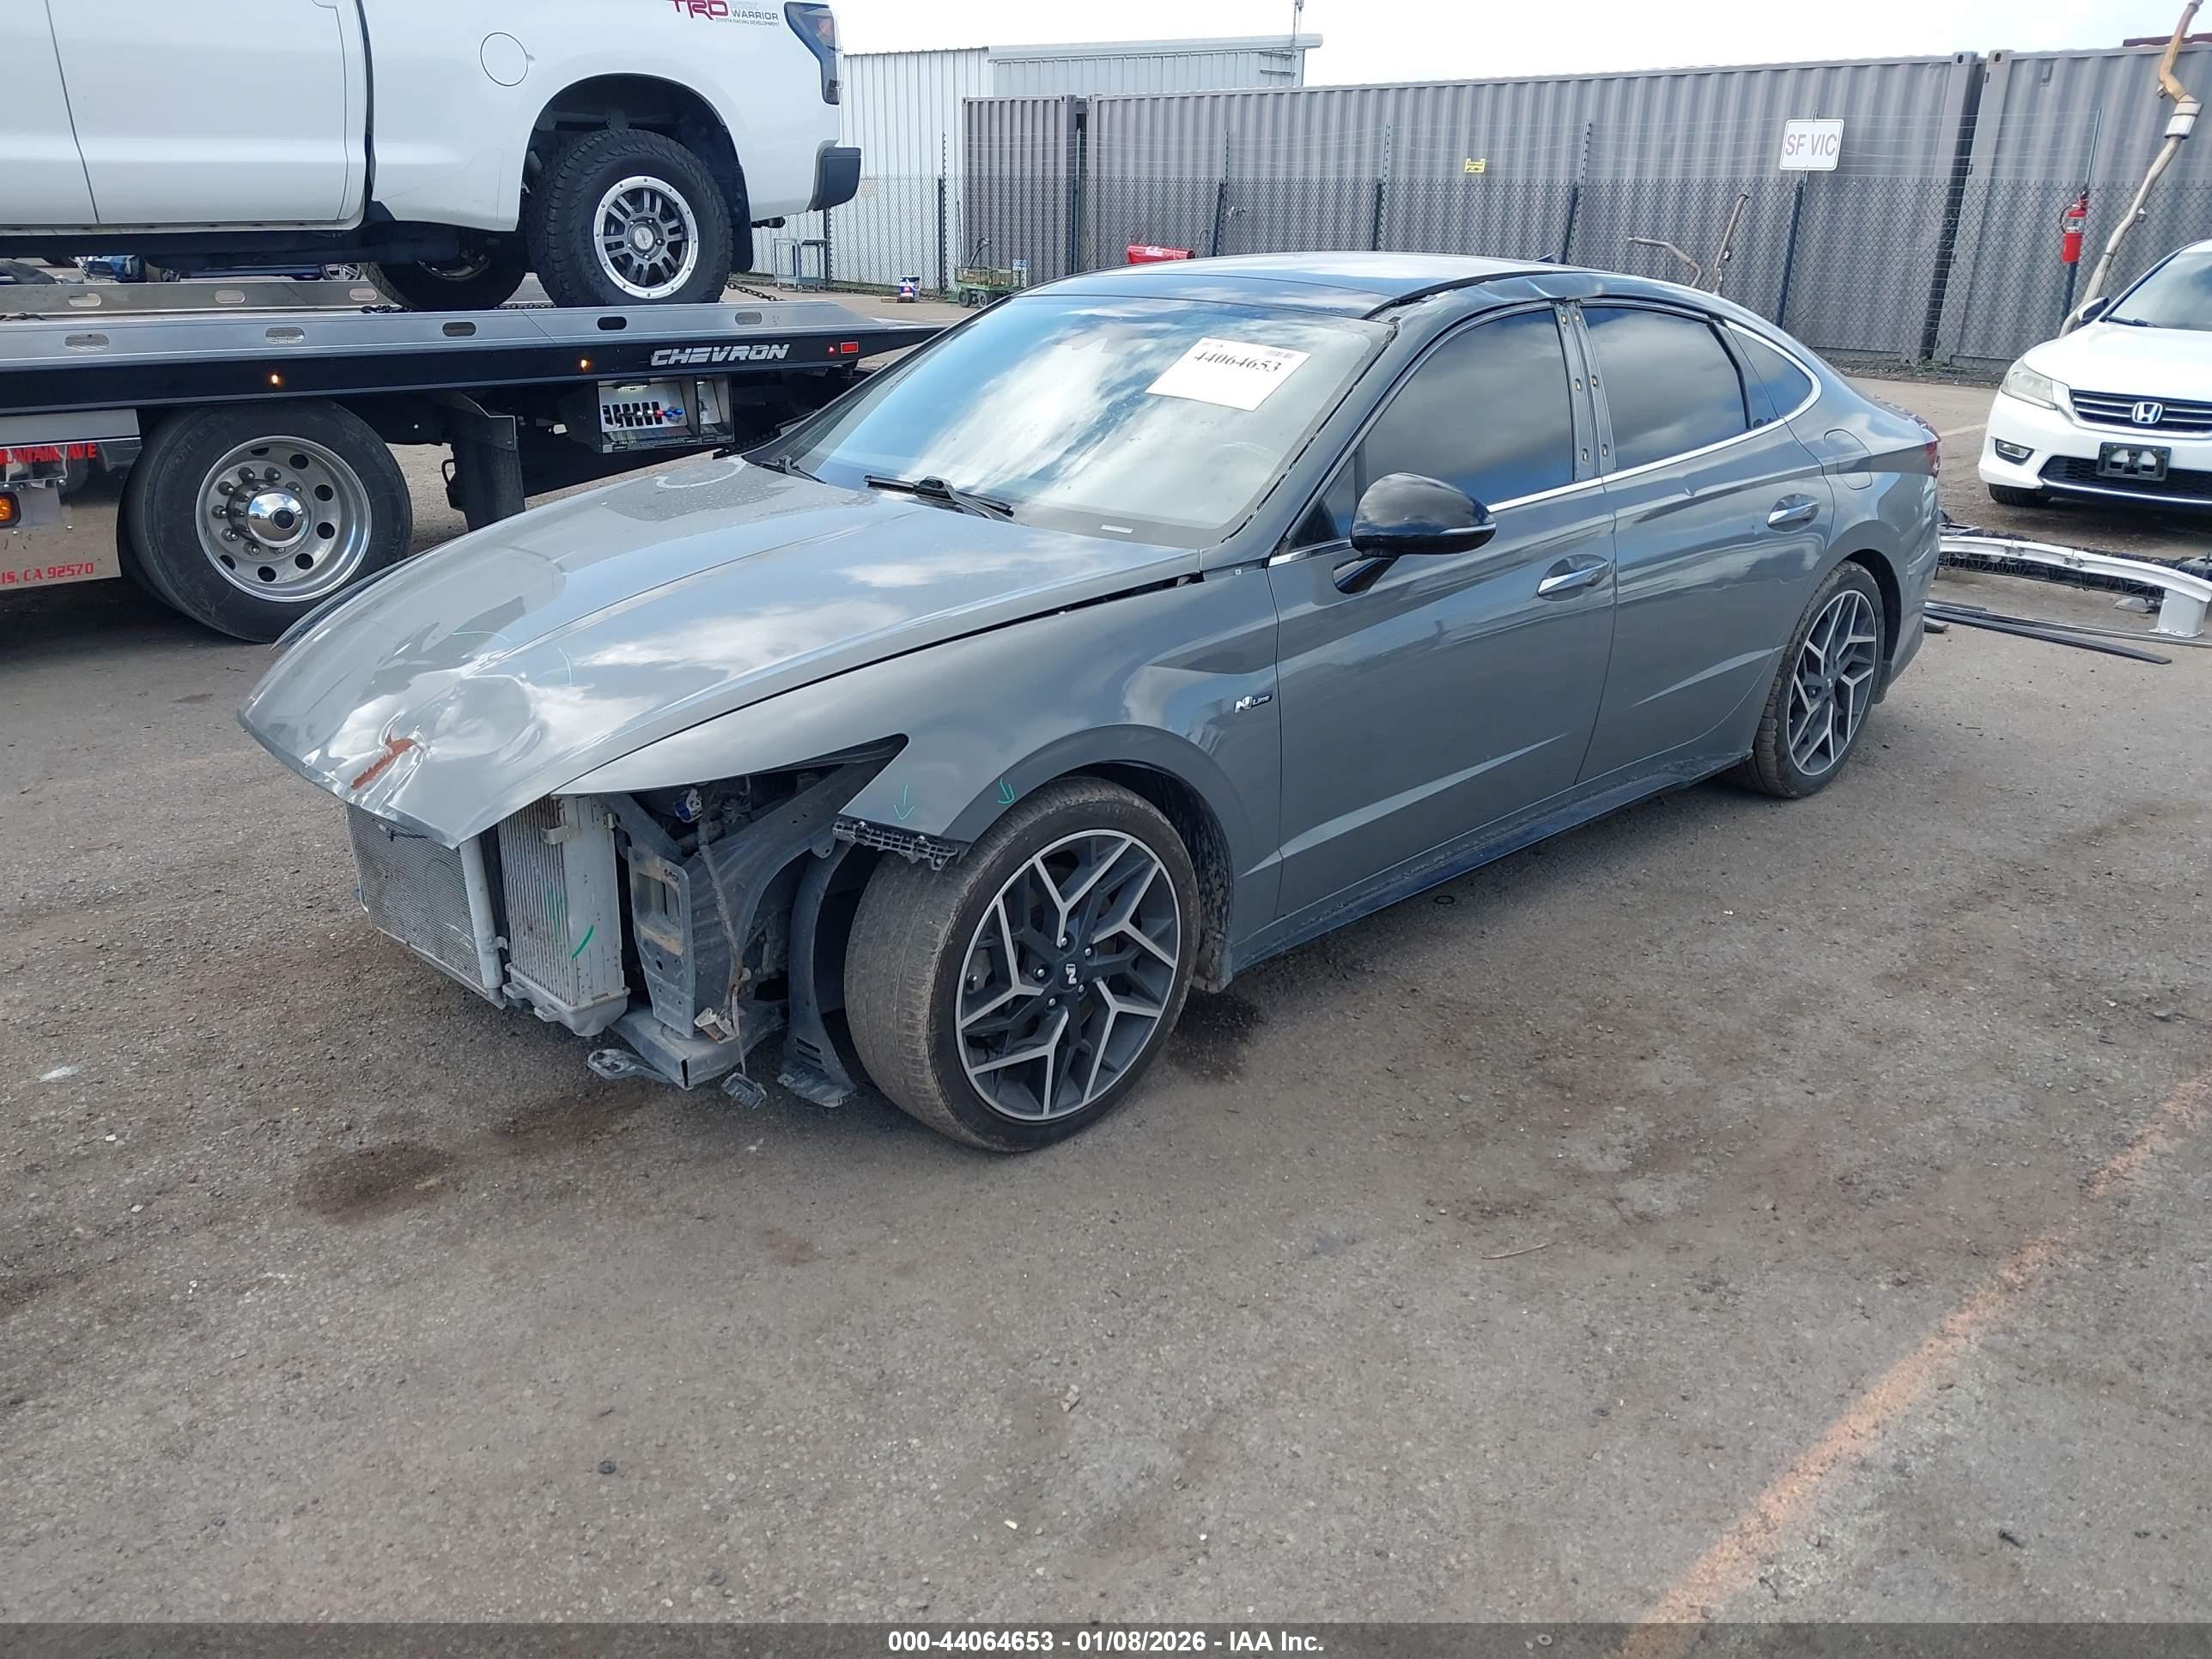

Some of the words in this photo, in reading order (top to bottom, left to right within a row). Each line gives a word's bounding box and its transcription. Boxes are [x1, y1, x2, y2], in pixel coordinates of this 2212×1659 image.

[667, 0, 729, 20] TRD
[731, 9, 780, 21] WARRIOR
[1785, 133, 1808, 156] SF
[1811, 133, 1838, 156] VIC
[650, 343, 791, 367] CHEVRON
[1194, 350, 1282, 373] 44064653
[68, 442, 97, 459] AVE
[23, 568, 42, 582] CA
[48, 562, 94, 579] 92570
